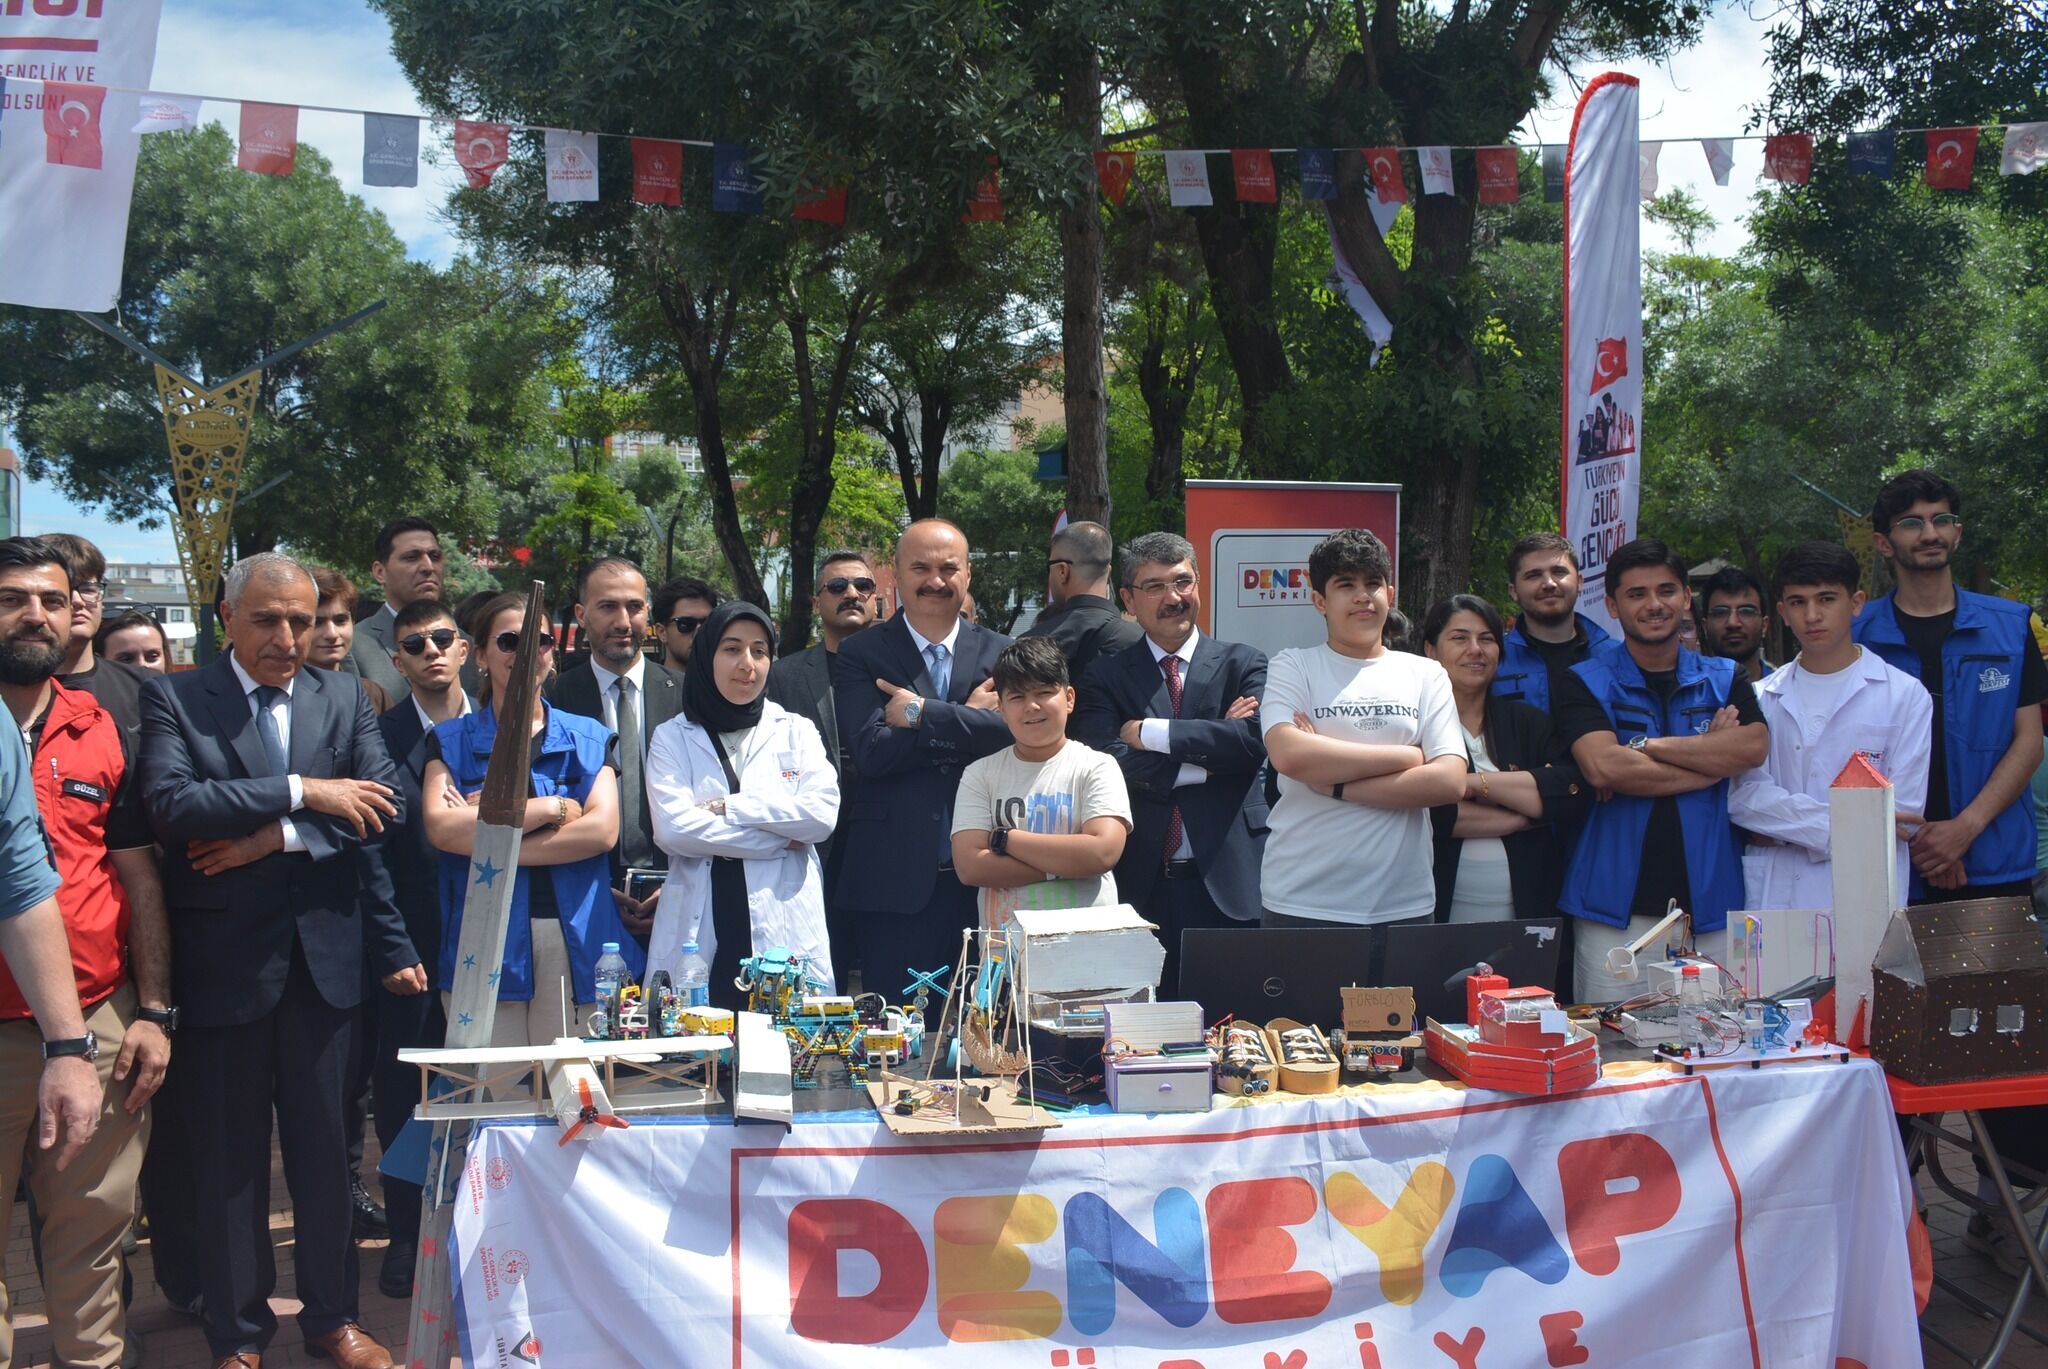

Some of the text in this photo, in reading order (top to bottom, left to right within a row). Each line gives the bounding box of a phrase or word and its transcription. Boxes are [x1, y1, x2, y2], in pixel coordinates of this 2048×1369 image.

[76, 66, 96, 82] VE
[1314, 704, 1419, 719] UNWAVERING
[74, 782, 100, 797] GÜZEL
[787, 1133, 1682, 1344] DENEYAP
